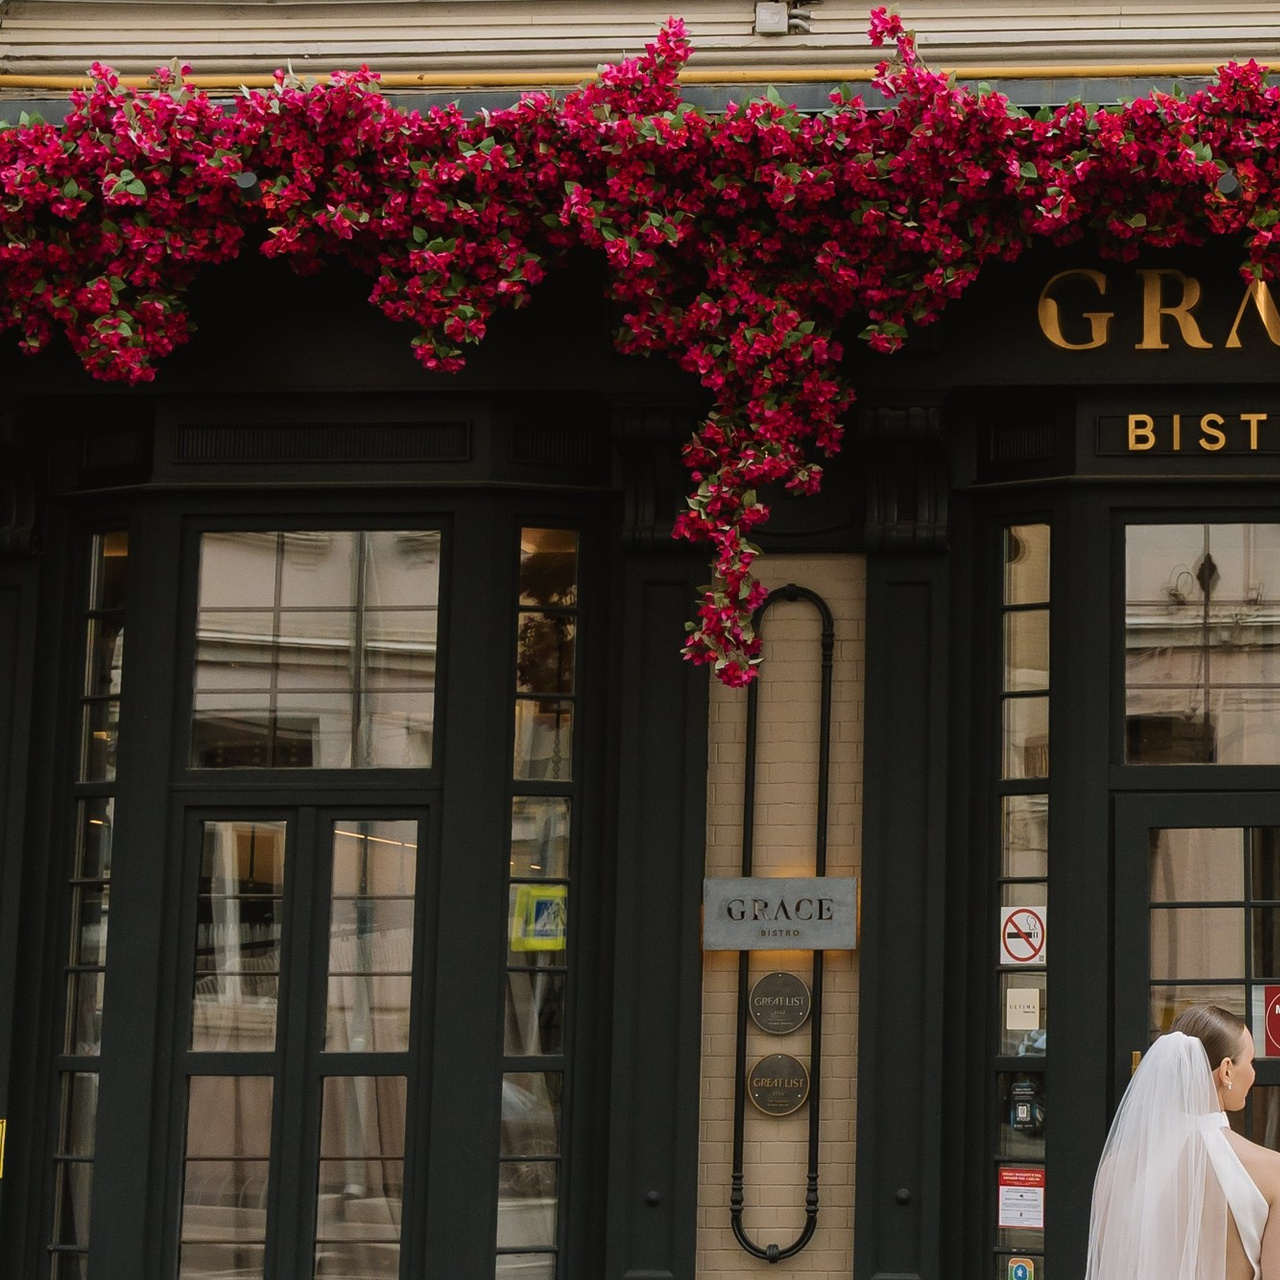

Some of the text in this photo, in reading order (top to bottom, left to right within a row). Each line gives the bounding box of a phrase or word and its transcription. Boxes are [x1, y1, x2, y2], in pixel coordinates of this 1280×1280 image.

[726, 898, 834, 922] GRACE
[760, 929, 800, 937] BISTRO
[754, 996, 805, 1006] GREAT LIST
[753, 1077, 804, 1088] GREAT LIST
